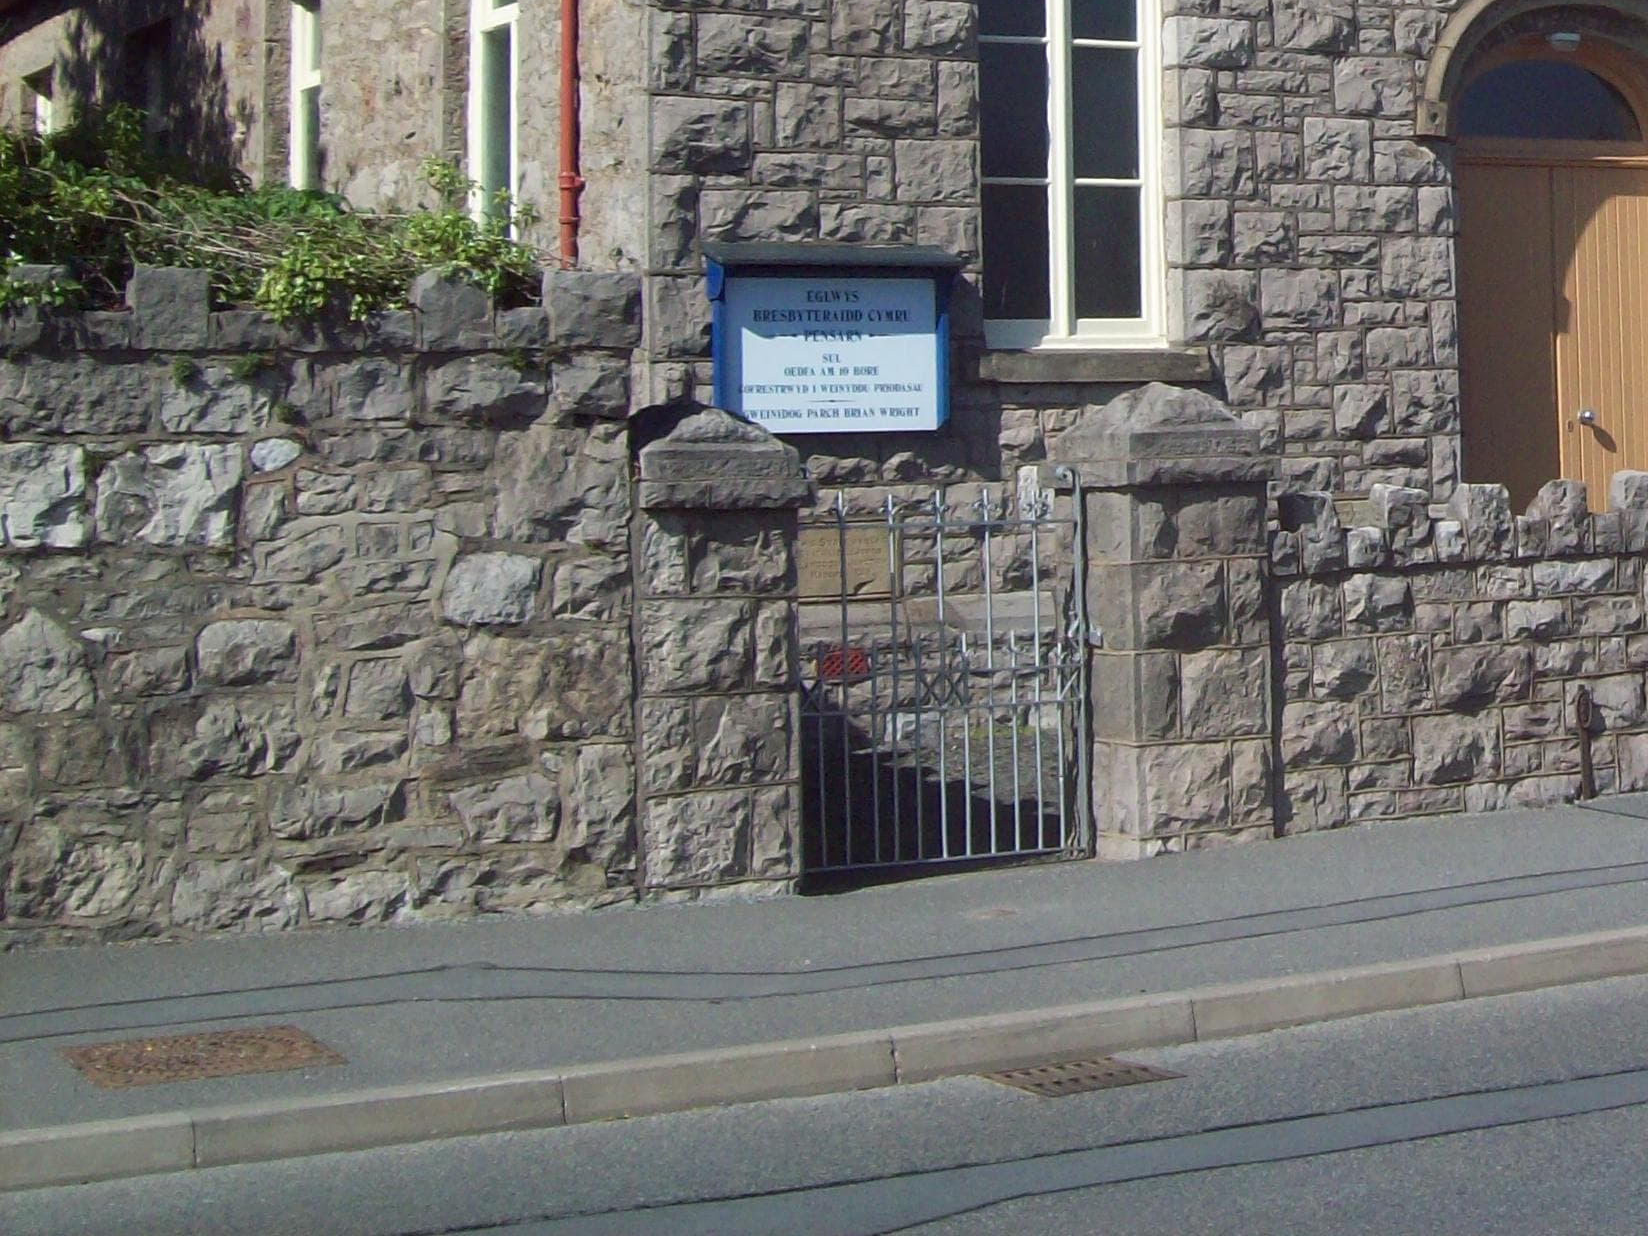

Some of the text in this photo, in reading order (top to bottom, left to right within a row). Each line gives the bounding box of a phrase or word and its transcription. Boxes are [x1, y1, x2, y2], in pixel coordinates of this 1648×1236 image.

[806, 290, 861, 303] EGLWYS
[753, 309, 911, 323] BRESBYTERAIDD CYMRU
[804, 329, 863, 342] PENSARN
[822, 354, 841, 364] SUL
[784, 367, 880, 377] OEDFA AM 10 BORE
[820, 384, 869, 394] WEINYDDU
[873, 383, 923, 393] PRIODASAU
[807, 408, 840, 419] PARCH
[844, 408, 876, 419] BRIAN
[879, 407, 920, 418] WRIGHT
